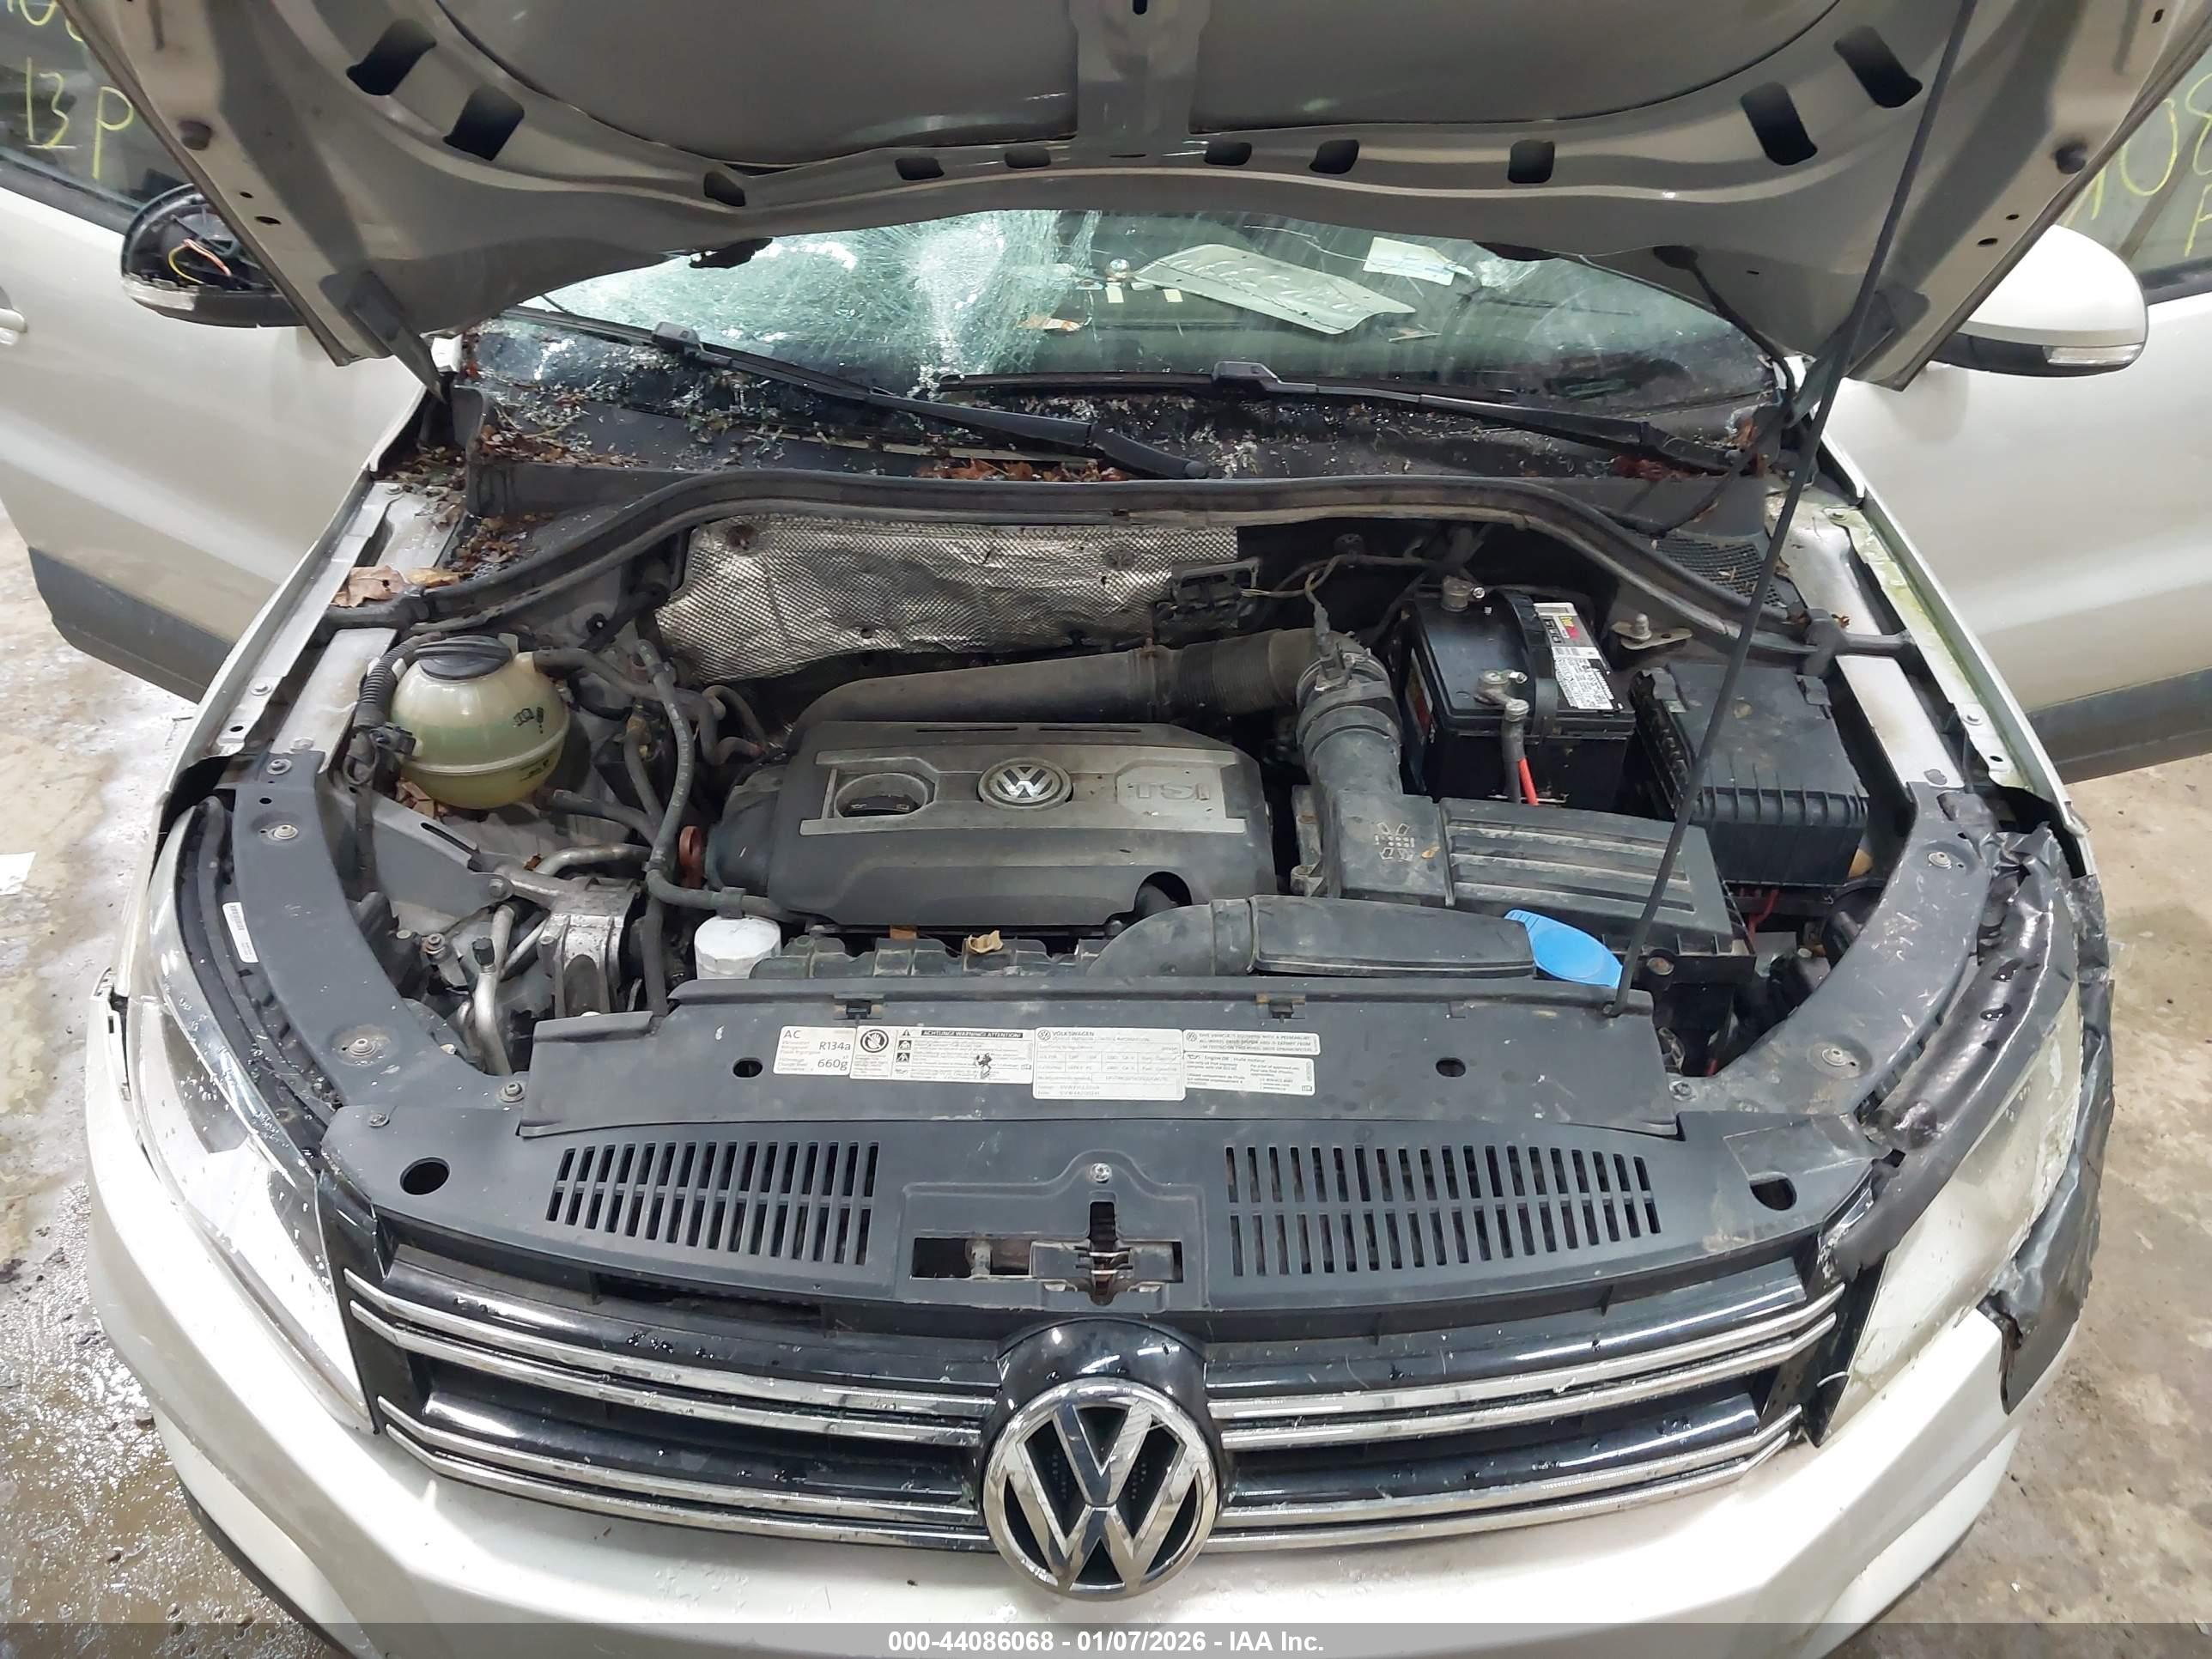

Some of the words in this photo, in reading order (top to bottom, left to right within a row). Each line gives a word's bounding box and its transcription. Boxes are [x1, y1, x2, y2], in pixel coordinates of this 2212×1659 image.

[1127, 782, 1210, 801] TSI
[783, 1030, 802, 1039] AC
[818, 1041, 852, 1051] R134a
[817, 1058, 848, 1072] 660g
